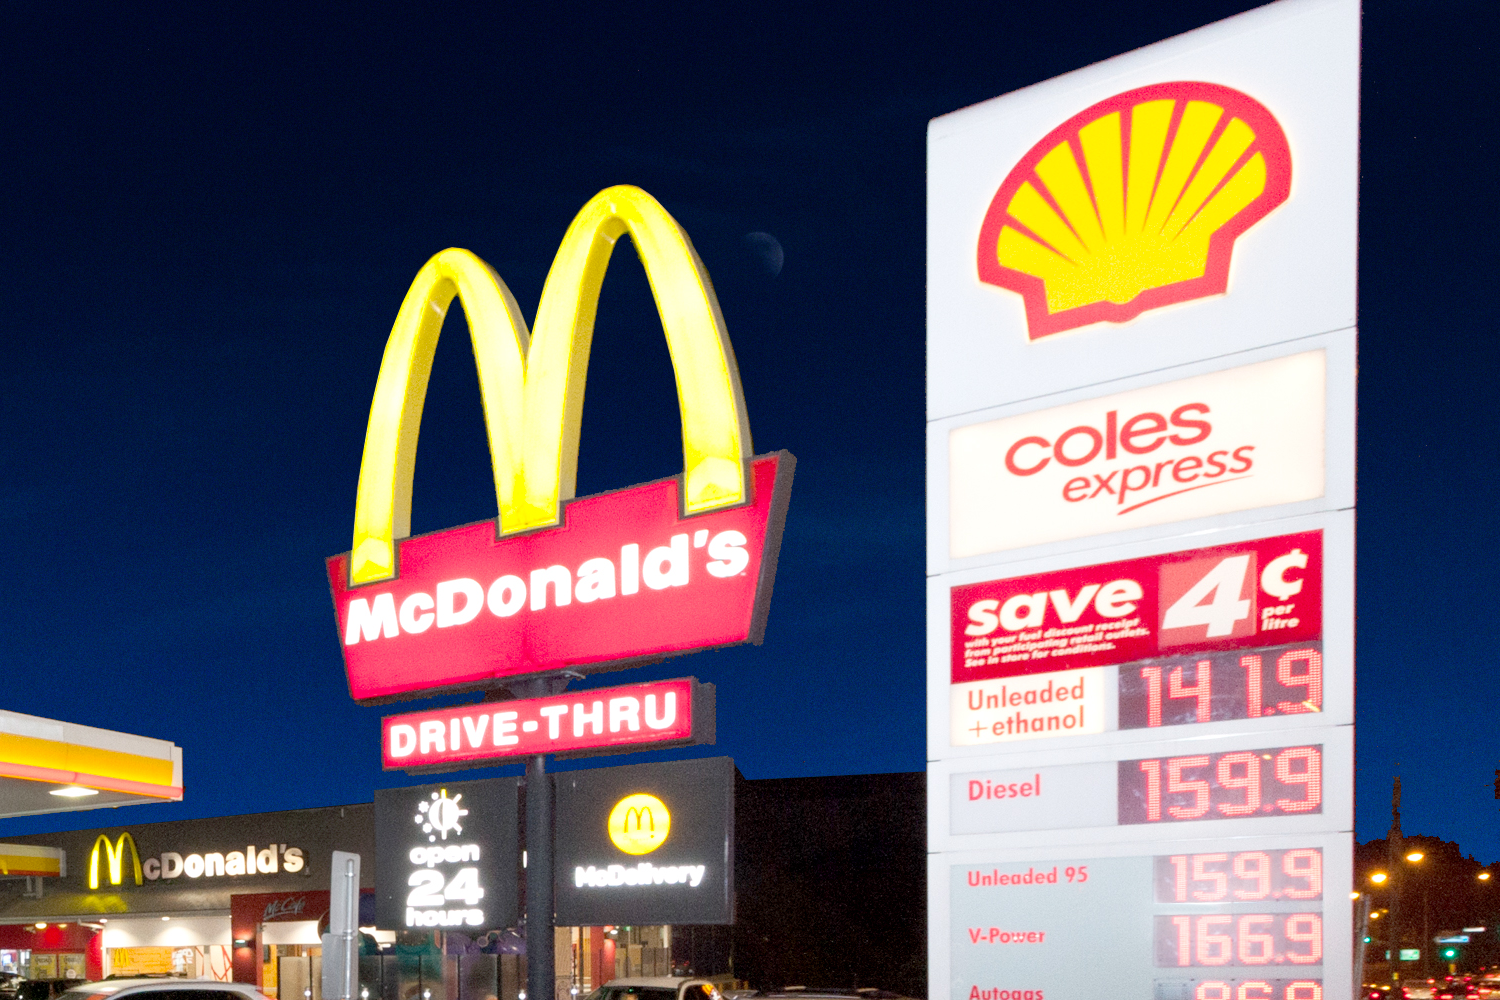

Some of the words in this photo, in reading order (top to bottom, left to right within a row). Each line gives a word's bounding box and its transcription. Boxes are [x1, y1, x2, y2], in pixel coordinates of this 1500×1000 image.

[1004, 402, 1213, 477] coles
[1062, 444, 1256, 505] express
[344, 529, 749, 645] McDonald's
[964, 578, 1143, 636] save
[1261, 614, 1301, 631] litre
[1262, 603, 1295, 621] per
[964, 637, 989, 649] with
[991, 634, 1016, 648] your
[1018, 631, 1042, 642] fuel
[1043, 624, 1094, 639] discount
[1095, 618, 1140, 632] receipt
[964, 647, 991, 658] from
[993, 637, 1069, 656] participating
[1070, 632, 1104, 645] retail
[964, 657, 986, 668] See
[987, 655, 1000, 665] in
[1001, 652, 1030, 663] store
[1031, 649, 1050, 660] for
[968, 676, 1085, 711] Unleaded
[1140, 648, 1323, 728] 141.9
[390, 692, 677, 758] DRIVE-THRU
[968, 708, 1085, 739] +ethanol
[968, 774, 1041, 801] Diesel
[1140, 746, 1323, 821] 159.9
[409, 844, 480, 866] open
[968, 868, 1058, 887] Unleaded
[1063, 866, 1089, 884] 95
[1170, 848, 1323, 901] 159.9
[407, 867, 484, 906] 24
[575, 863, 705, 888] McDelivery
[406, 906, 484, 928] hours
[968, 927, 1045, 945] V-Power
[1173, 913, 1323, 966] 166.9
